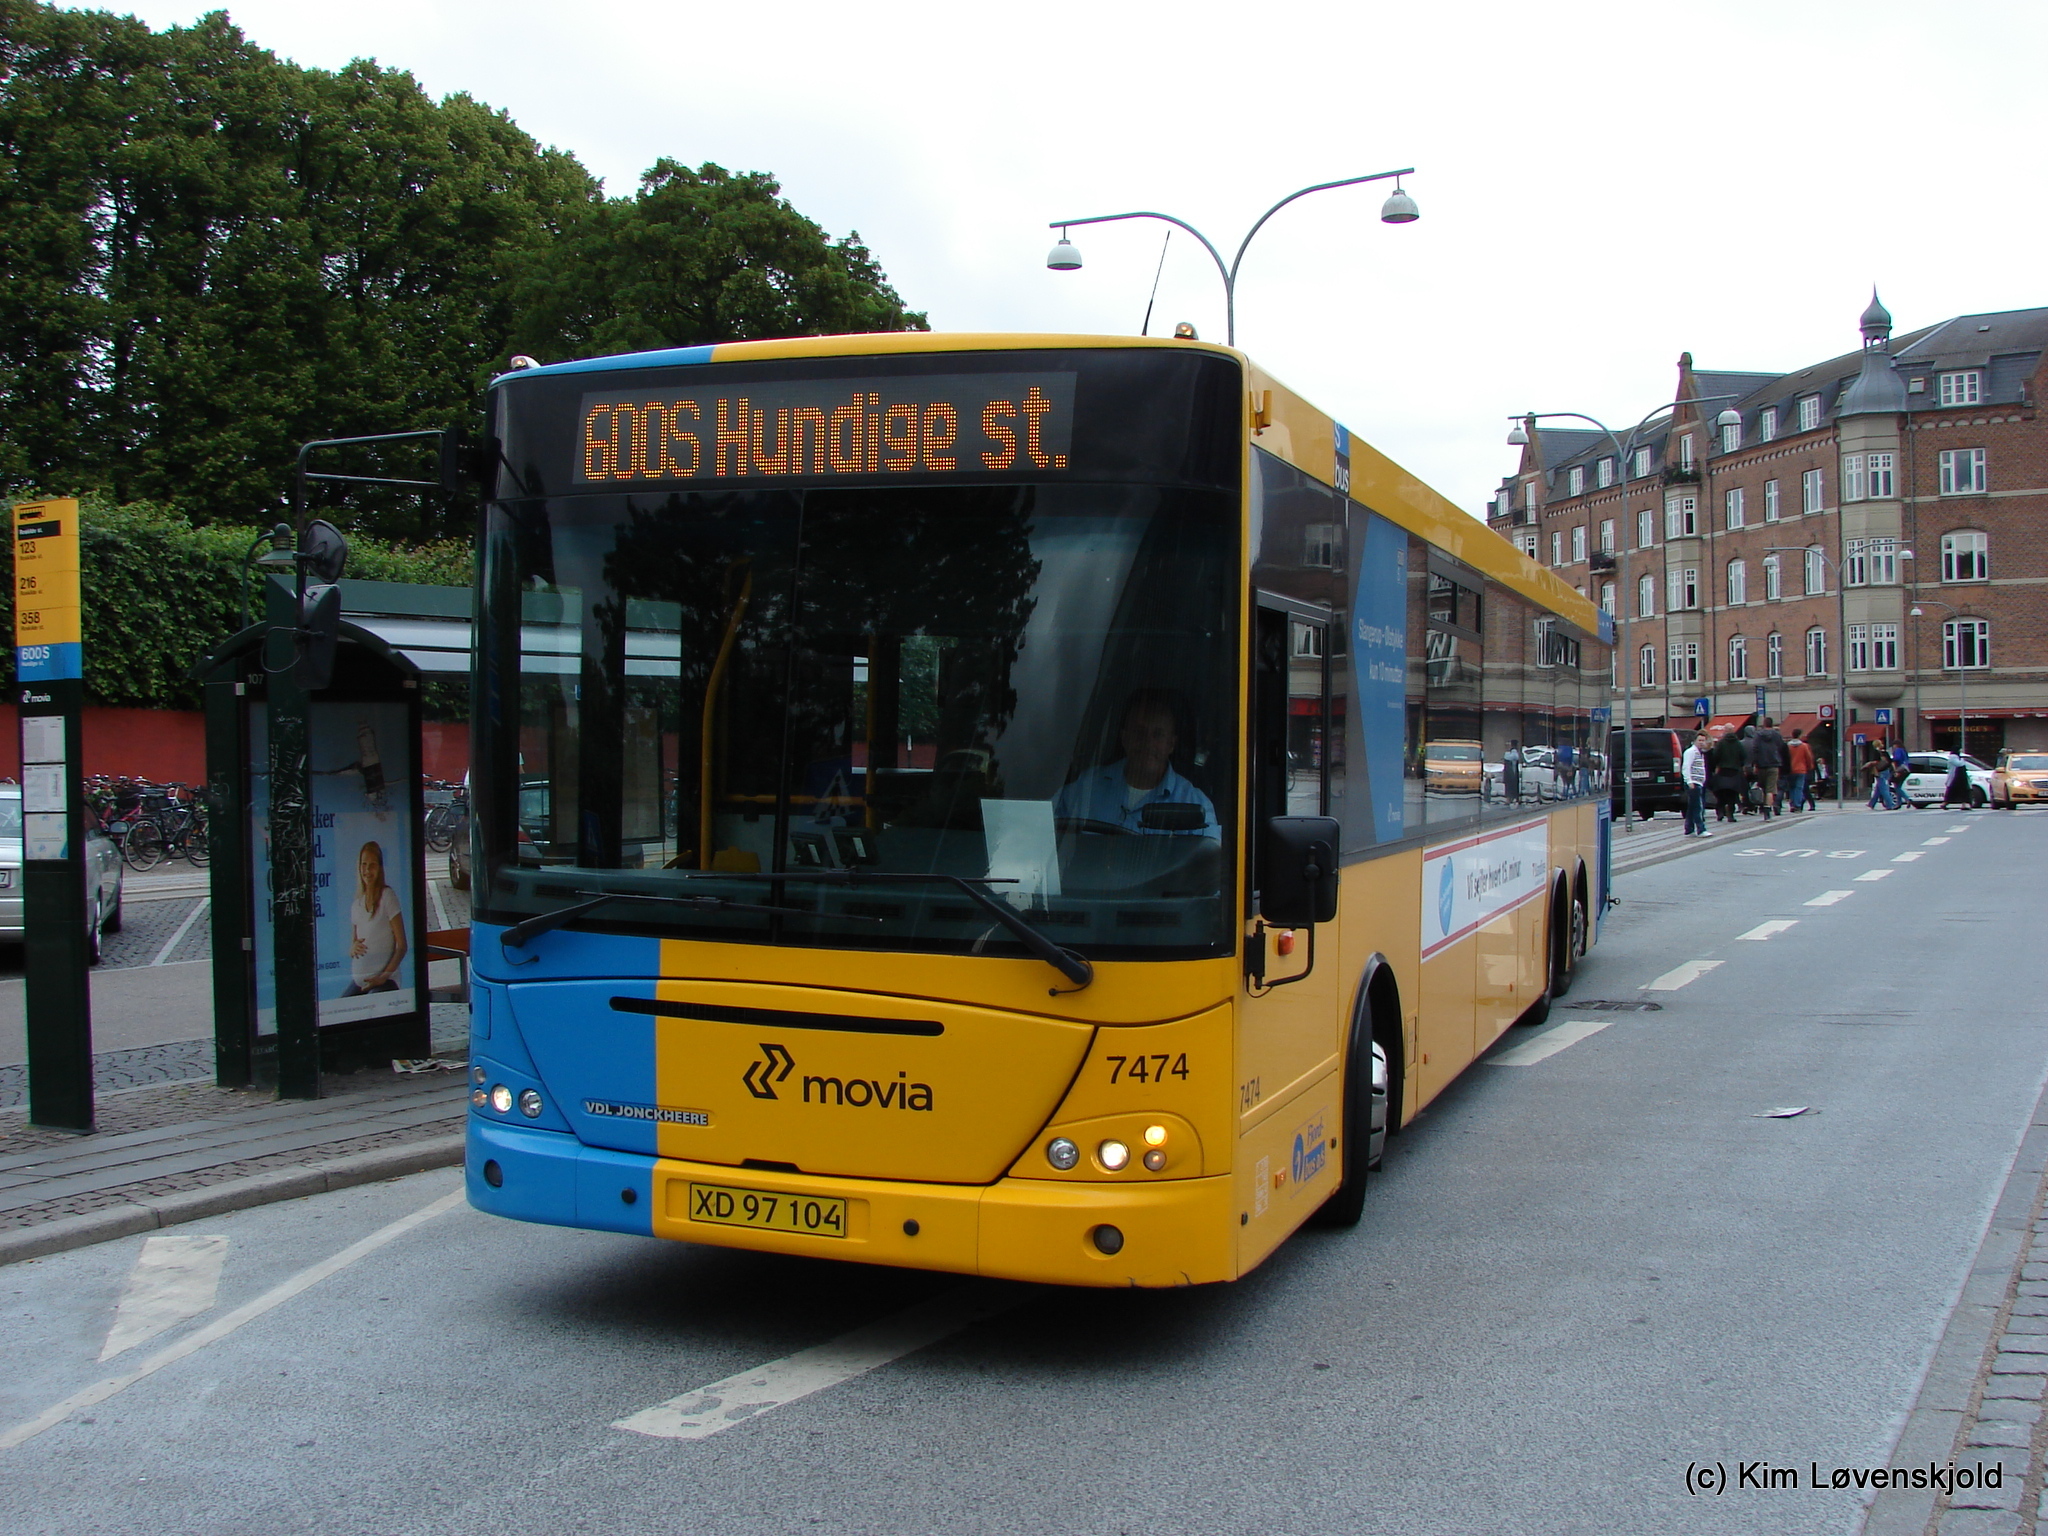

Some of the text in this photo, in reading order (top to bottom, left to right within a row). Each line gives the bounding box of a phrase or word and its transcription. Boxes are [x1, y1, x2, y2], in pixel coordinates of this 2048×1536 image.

[584, 385, 1067, 480] 600S Hundige st.
[1335, 455, 1350, 493] bus
[19, 541, 36, 554] 123
[20, 576, 37, 590] 216
[21, 611, 41, 625] 358
[247, 673, 264, 685] 107
[1733, 848, 1867, 859] BUS
[1106, 1052, 1190, 1085] 7474
[803, 1070, 934, 1112] movia
[1240, 1075, 1261, 1112] 7474
[585, 1101, 709, 1125] VDL JONCKHEERE
[695, 1189, 841, 1231] XD 97 104
